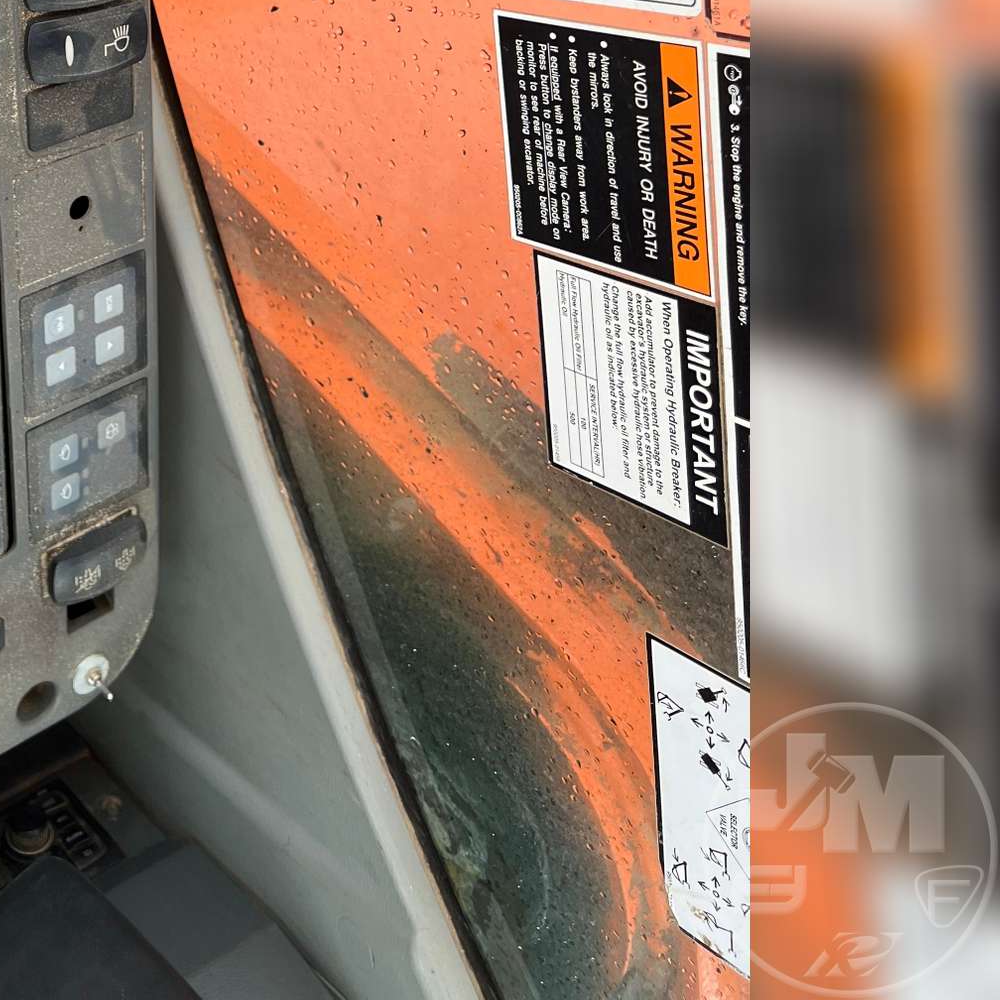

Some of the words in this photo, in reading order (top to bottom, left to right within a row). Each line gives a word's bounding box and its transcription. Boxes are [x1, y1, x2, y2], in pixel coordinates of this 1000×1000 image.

[515, 39, 525, 75] backing
[526, 40, 536, 77] monitor
[537, 43, 546, 70] Press
[568, 48, 577, 74] Keep
[587, 52, 597, 68] the
[550, 55, 562, 101] equipped
[600, 53, 609, 88] Always
[518, 79, 526, 90] or
[529, 81, 538, 91] to
[540, 74, 549, 104] button
[589, 71, 598, 109] mirrors.
[632, 60, 648, 108] AVOID
[519, 94, 530, 134] swinging
[530, 95, 538, 112] see
[543, 109, 551, 119] to
[554, 104, 563, 124] with
[570, 77, 582, 130] bystanders
[602, 92, 613, 114] look
[532, 115, 540, 136] rear
[604, 118, 613, 127] in
[730, 123, 739, 132] 3.
[534, 139, 543, 149] of
[542, 121, 553, 158] change
[556, 138, 565, 162] Rear
[574, 134, 583, 160] away
[605, 131, 616, 174] direction
[636, 115, 652, 172] INJURY
[730, 136, 740, 162] Stop
[523, 138, 534, 185] excavator.
[535, 152, 546, 192] machine
[732, 164, 742, 181] the
[545, 157, 557, 194] display
[559, 166, 568, 188] View
[576, 164, 586, 186] from
[608, 178, 618, 189] of
[579, 191, 589, 214] work
[640, 178, 654, 202] OR
[670, 124, 699, 261] WARNING
[732, 183, 743, 220] engine
[539, 195, 548, 225] before
[550, 197, 560, 224] mode
[609, 192, 620, 220] travel
[552, 227, 560, 240] on
[581, 217, 589, 240] area.
[611, 222, 622, 242] and
[642, 207, 657, 259] DEATH
[735, 222, 745, 244] and
[613, 245, 621, 262] use
[736, 245, 745, 284] remove
[601, 282, 612, 325] hydraulic
[611, 285, 619, 321] Change
[626, 290, 635, 325] caused
[644, 295, 653, 316] Add
[738, 286, 747, 303] the
[635, 293, 645, 347] excavator's
[661, 302, 671, 334] When
[738, 305, 748, 325] key.
[605, 327, 613, 340] oil
[628, 326, 636, 338] by
[606, 341, 612, 352] as
[615, 340, 623, 356] full
[645, 317, 655, 378] accumulator
[607, 354, 617, 398] indicated
[616, 357, 624, 377] flow
[629, 340, 639, 386] excessive
[638, 349, 648, 393] hydraulic
[662, 338, 675, 396] Operating
[649, 379, 656, 389] to
[616, 379, 627, 422] hydraulic
[632, 388, 642, 432] hydraulic
[641, 395, 650, 430] system
[648, 390, 659, 427] prevent
[620, 424, 628, 437] oil
[666, 399, 679, 455] Hydraulic
[685, 329, 718, 515] IMPORTANT
[621, 438, 629, 459] filter
[644, 432, 650, 442] or
[652, 429, 660, 466] damage
[623, 460, 631, 479] and
[644, 444, 653, 486] structure
[654, 468, 662, 478] to
[655, 480, 663, 495] the
[719, 814, 727, 837] VALVE
[729, 813, 738, 849] SELECTOR
